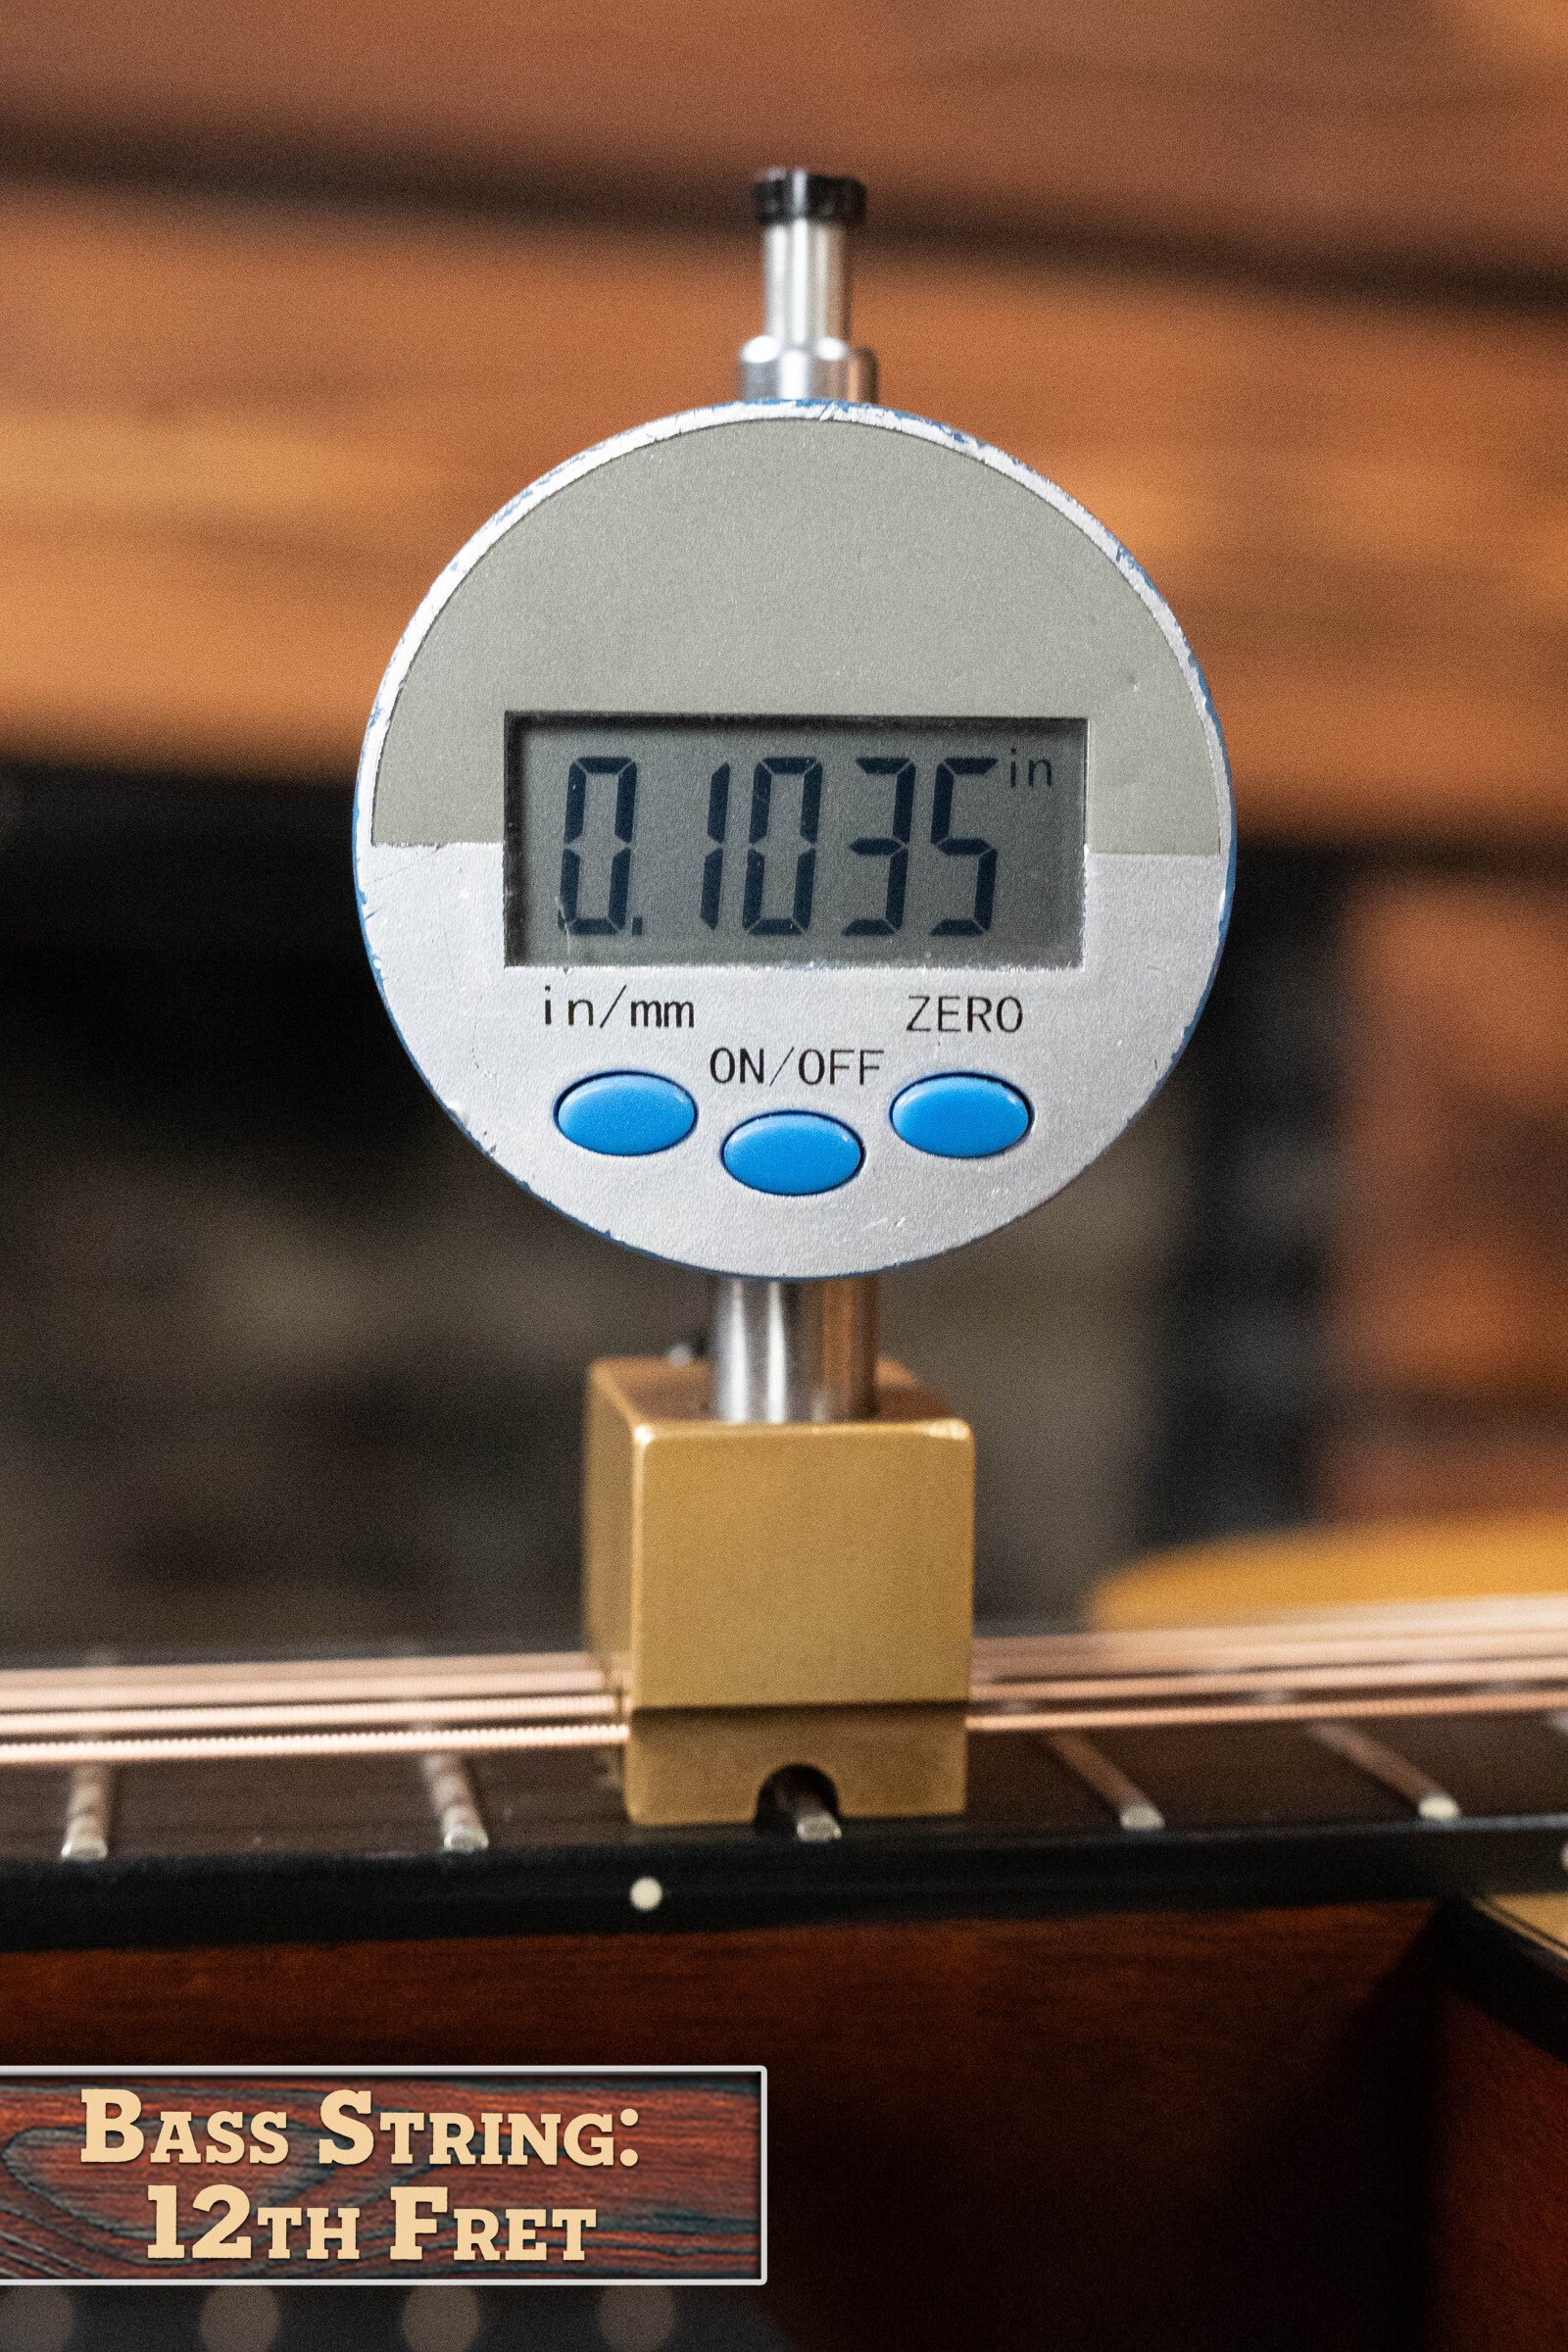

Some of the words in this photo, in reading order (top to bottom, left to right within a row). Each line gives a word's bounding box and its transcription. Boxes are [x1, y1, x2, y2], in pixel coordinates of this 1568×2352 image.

[560, 756, 998, 936] 0.1035
[1008, 747, 1054, 787] in
[543, 984, 696, 1029] in/mm
[906, 995, 1024, 1033] ZERO
[709, 1046, 885, 1087] ON/OFF
